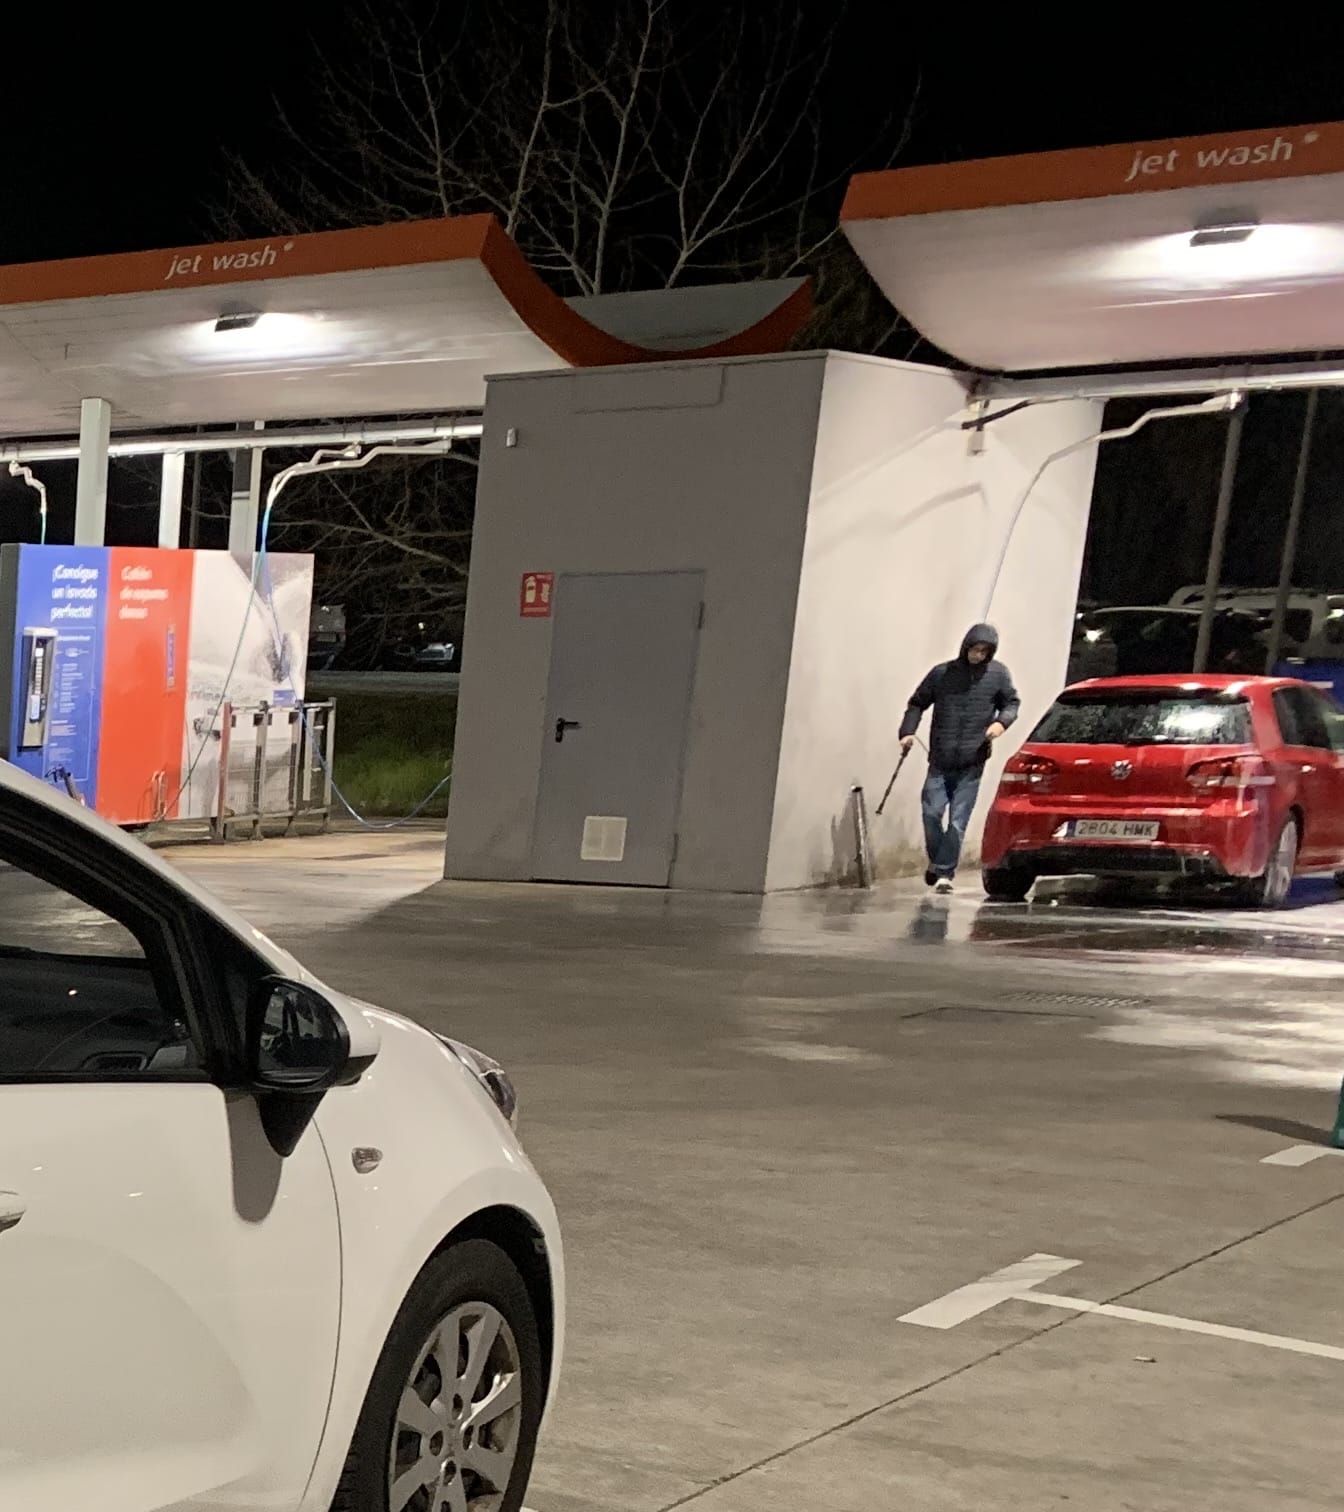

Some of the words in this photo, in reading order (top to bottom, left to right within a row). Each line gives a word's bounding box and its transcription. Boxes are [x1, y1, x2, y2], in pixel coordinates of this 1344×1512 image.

[1124, 150, 1179, 182] jet
[1197, 136, 1293, 168] wash
[164, 254, 202, 280] jet
[213, 245, 277, 270] wash
[1078, 821, 1118, 835] 2804
